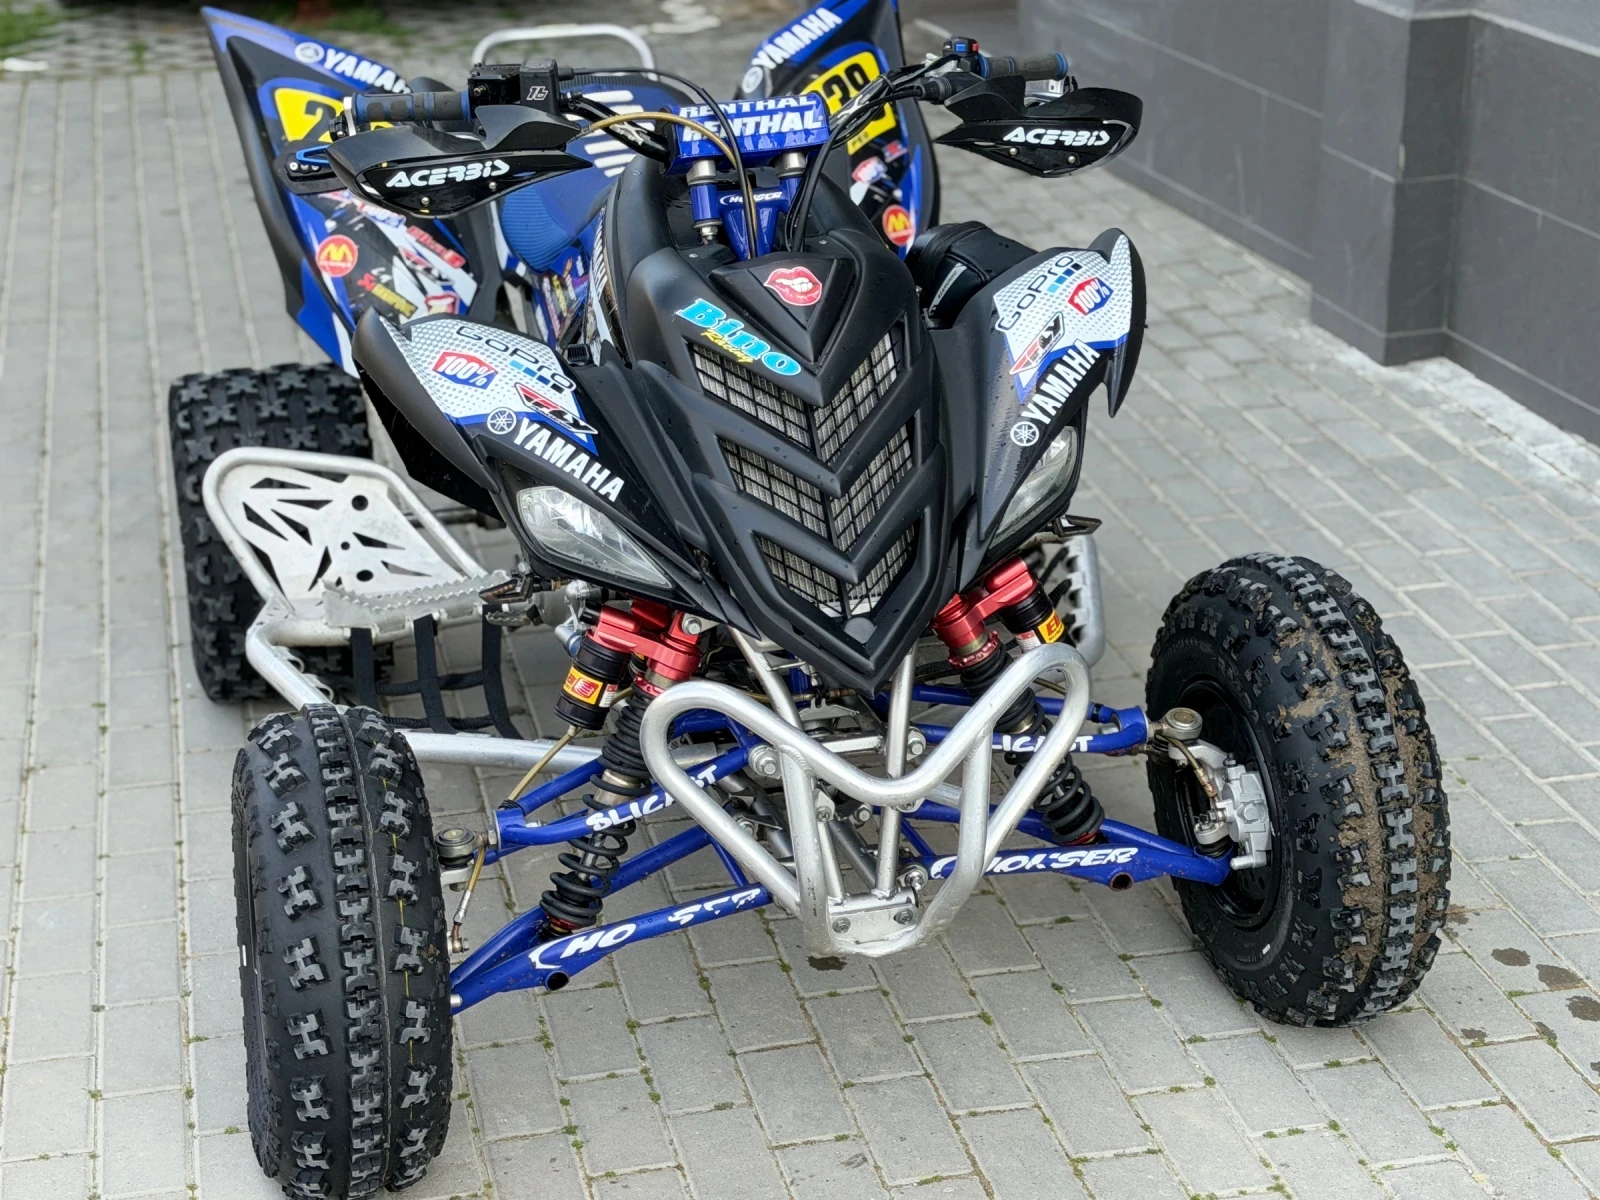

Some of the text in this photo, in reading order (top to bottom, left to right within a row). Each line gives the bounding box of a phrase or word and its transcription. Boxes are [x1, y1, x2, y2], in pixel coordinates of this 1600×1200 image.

[752, 8, 843, 70] YAMAHA
[526, 86, 549, 101] 16
[1074, 278, 1111, 313] 100%
[436, 355, 496, 387] 100%
[1021, 339, 1101, 425] YAMAHA
[513, 417, 625, 502] YAMAHA
